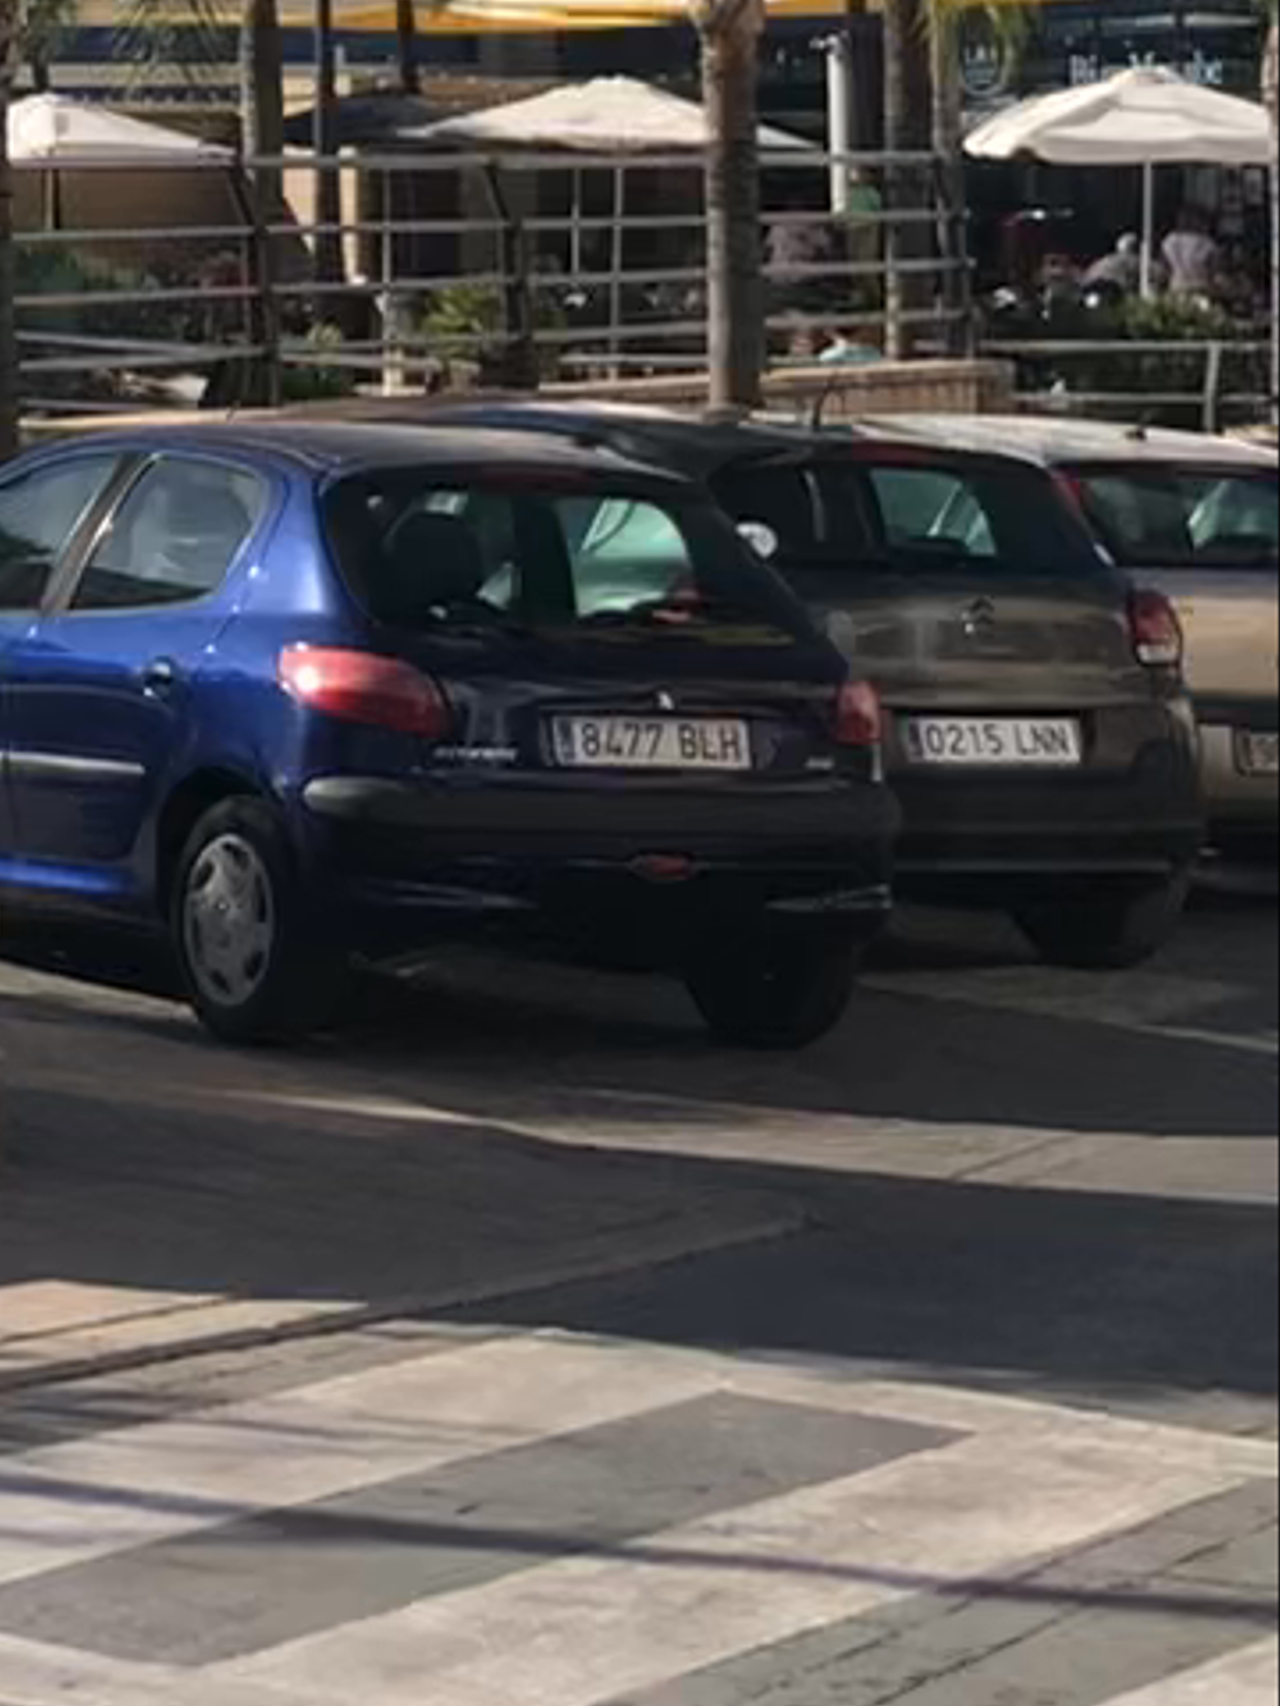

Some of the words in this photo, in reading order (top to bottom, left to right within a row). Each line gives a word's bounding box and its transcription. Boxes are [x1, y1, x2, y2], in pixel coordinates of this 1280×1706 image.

[580, 722, 664, 759] 8477
[678, 726, 740, 760] BLH
[925, 722, 1004, 757] 0215
[1013, 722, 1071, 757] LNN
